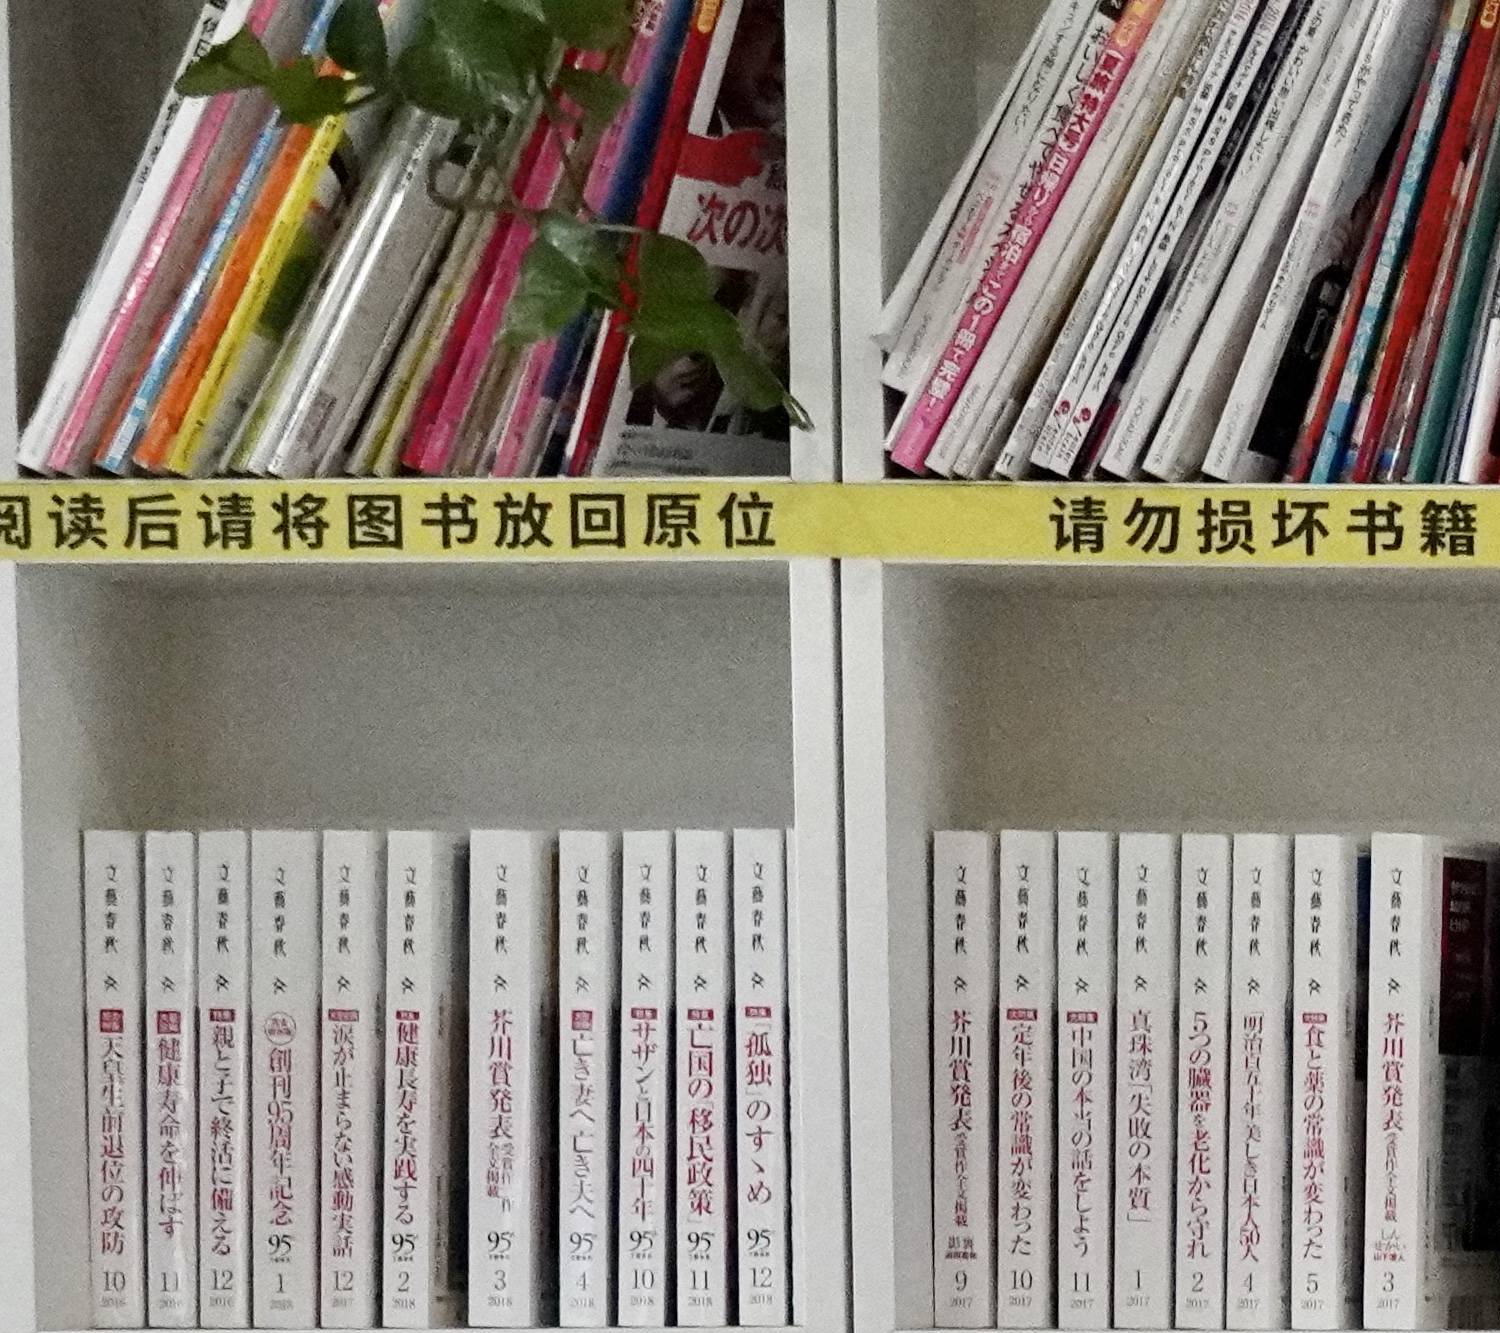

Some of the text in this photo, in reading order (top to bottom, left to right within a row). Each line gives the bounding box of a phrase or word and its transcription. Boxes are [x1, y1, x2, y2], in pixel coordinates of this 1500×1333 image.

[0, 492, 775, 549] 阅读后请将图书放回原位
[1050, 497, 1476, 556] 请勿损坏书籍
[949, 1010, 972, 1132] 芥川賞発表
[1010, 1023, 1033, 1256] 定年後の常識が変わった
[1071, 1028, 1093, 1257] 中国の本当の話をしよう
[1302, 1026, 1325, 1260] 食と薬の常識が変わった
